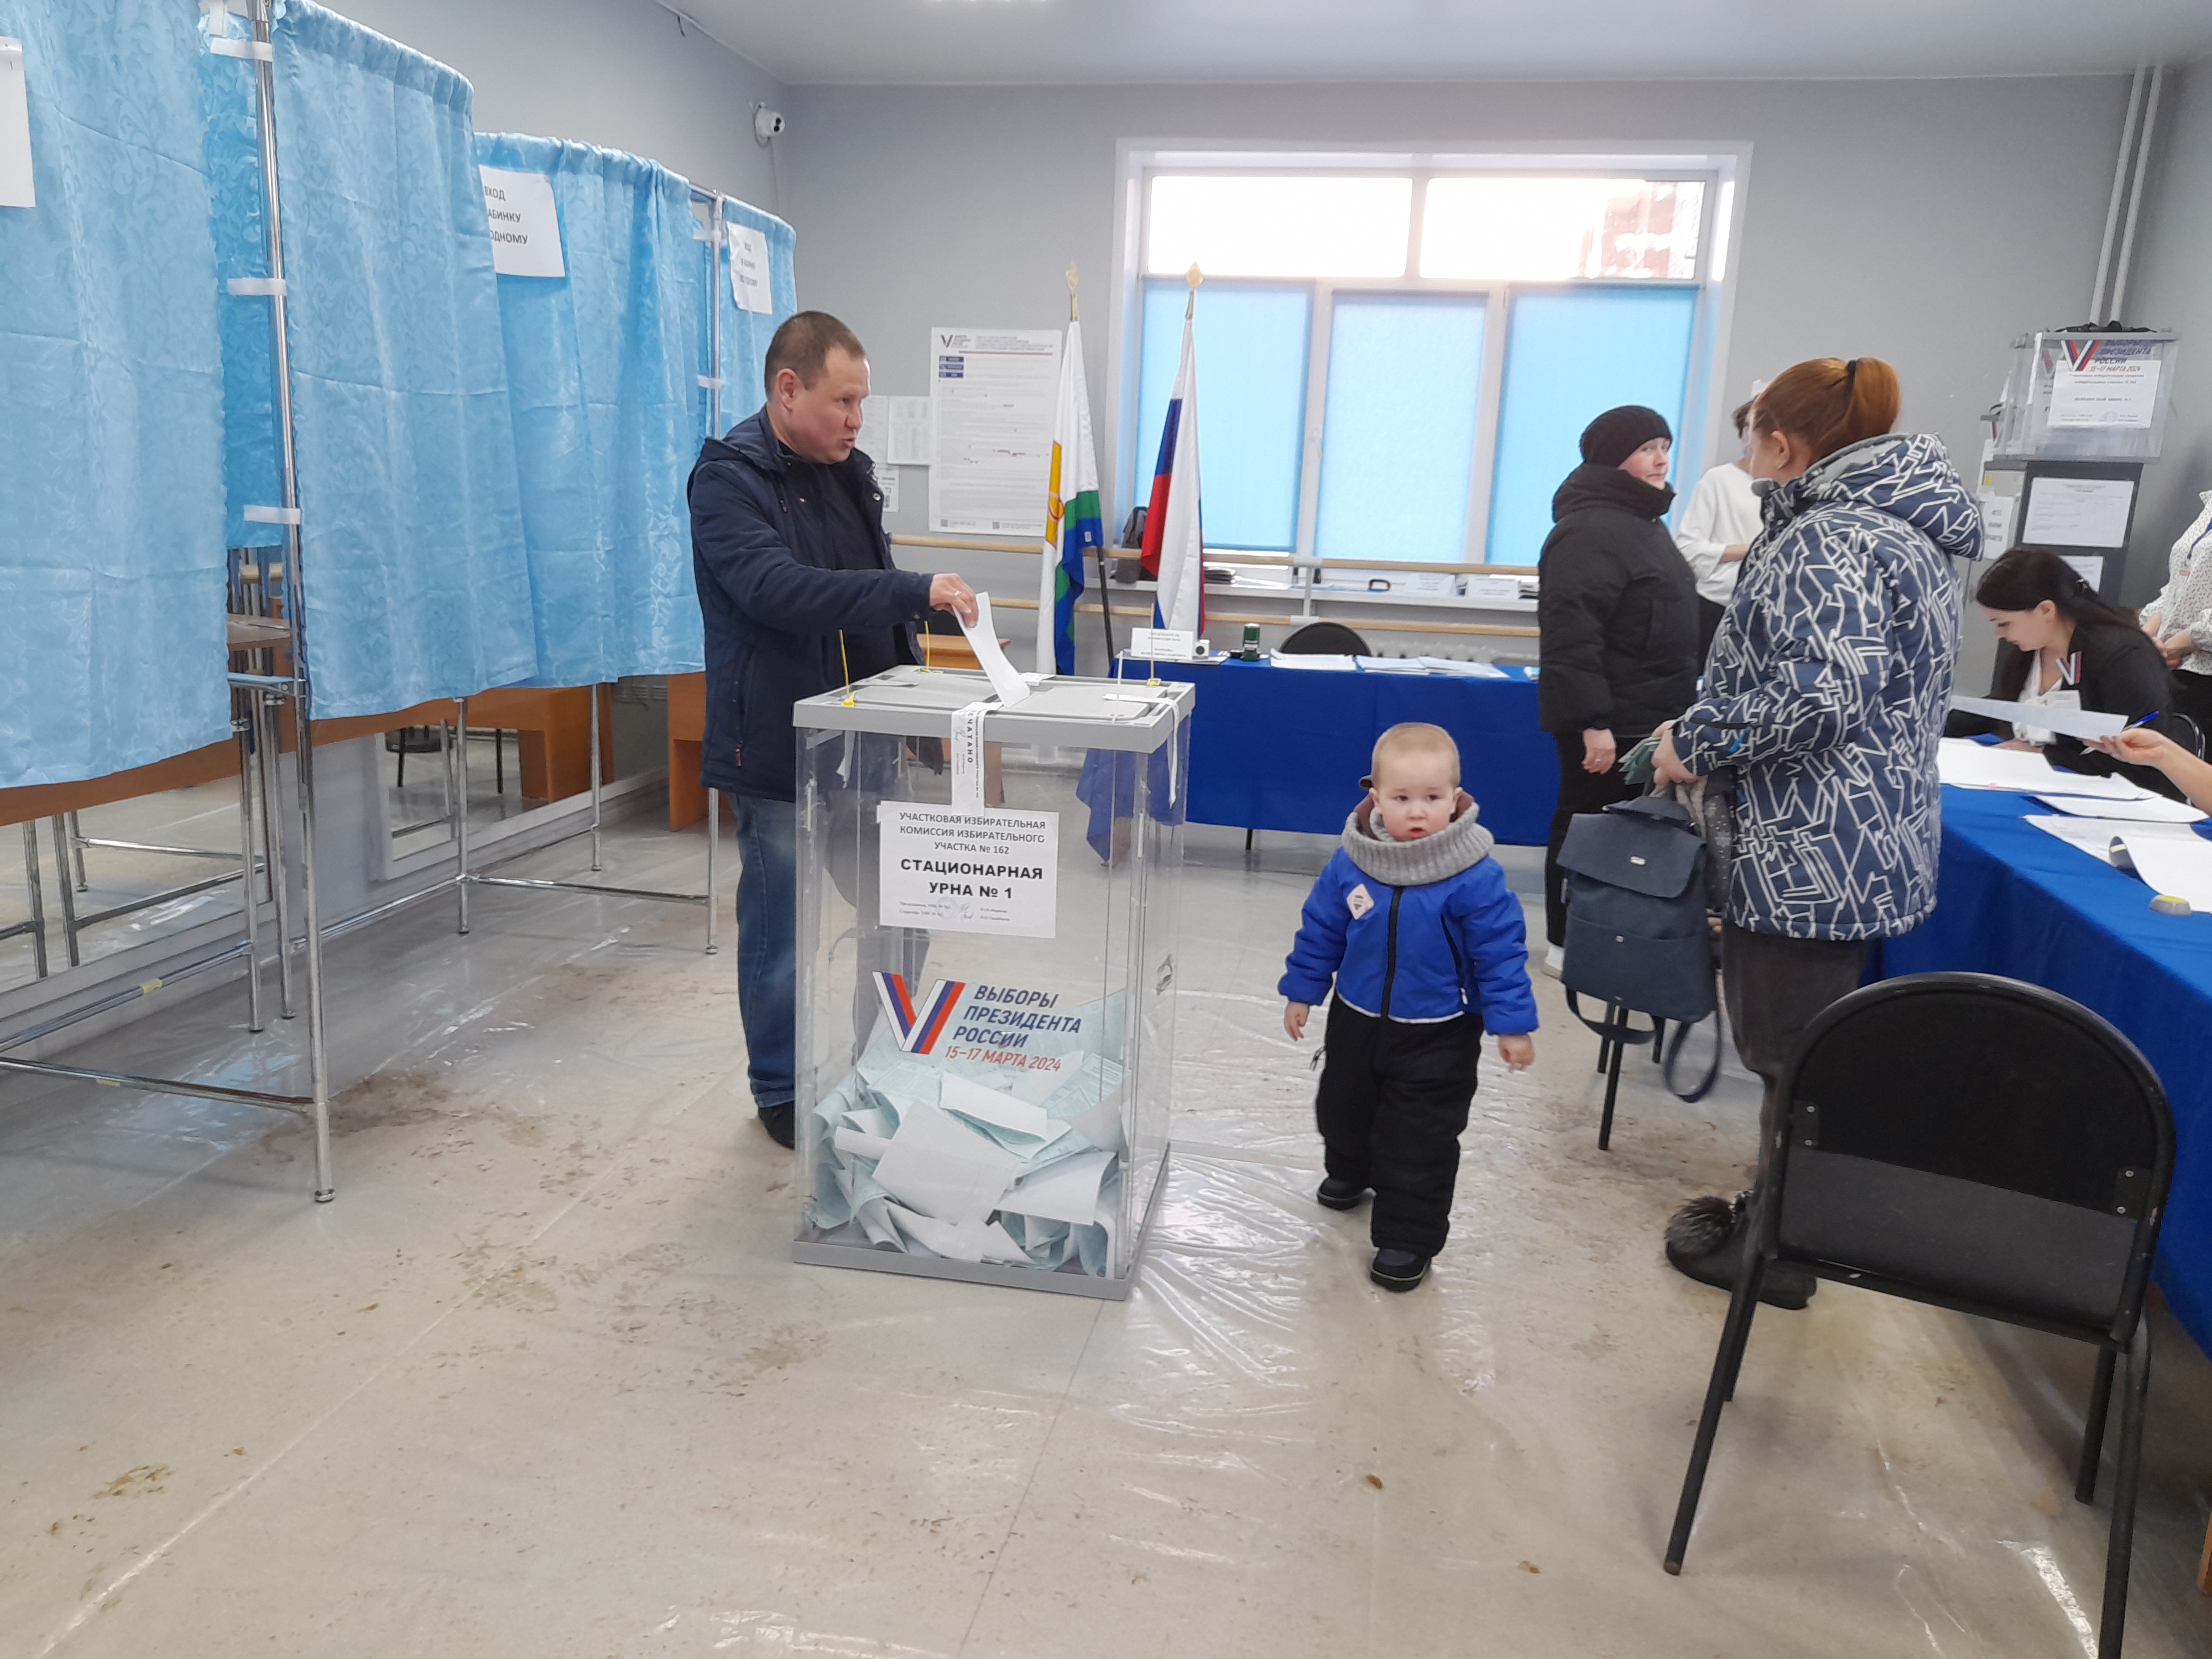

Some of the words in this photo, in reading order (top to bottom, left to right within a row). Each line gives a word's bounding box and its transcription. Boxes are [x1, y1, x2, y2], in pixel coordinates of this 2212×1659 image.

[488, 208, 521, 223] АБИНКУ
[899, 812, 961, 824] УЧАСТКОВАЯ
[964, 816, 1046, 830] ИЗБИРАТЕЛЬНАЯ
[900, 826, 954, 837] КОМИССИЯ
[934, 842, 977, 852] УЧАСТКА
[979, 844, 991, 853] №
[993, 846, 1010, 854] 162
[901, 858, 1043, 879] СТАЦИОНАРНАЯ
[929, 882, 973, 896] УРНА
[979, 886, 999, 898] №
[1004, 887, 1012, 899] 1
[974, 984, 1060, 1009] ВЫБОРЫ
[963, 1005, 1082, 1033] ПРЕЗИДЕНТА
[952, 1026, 1029, 1048] РОССИИ
[945, 1045, 982, 1061] 15–17
[981, 1050, 1027, 1067] МАРТА
[1028, 1056, 1062, 1072] 2024
